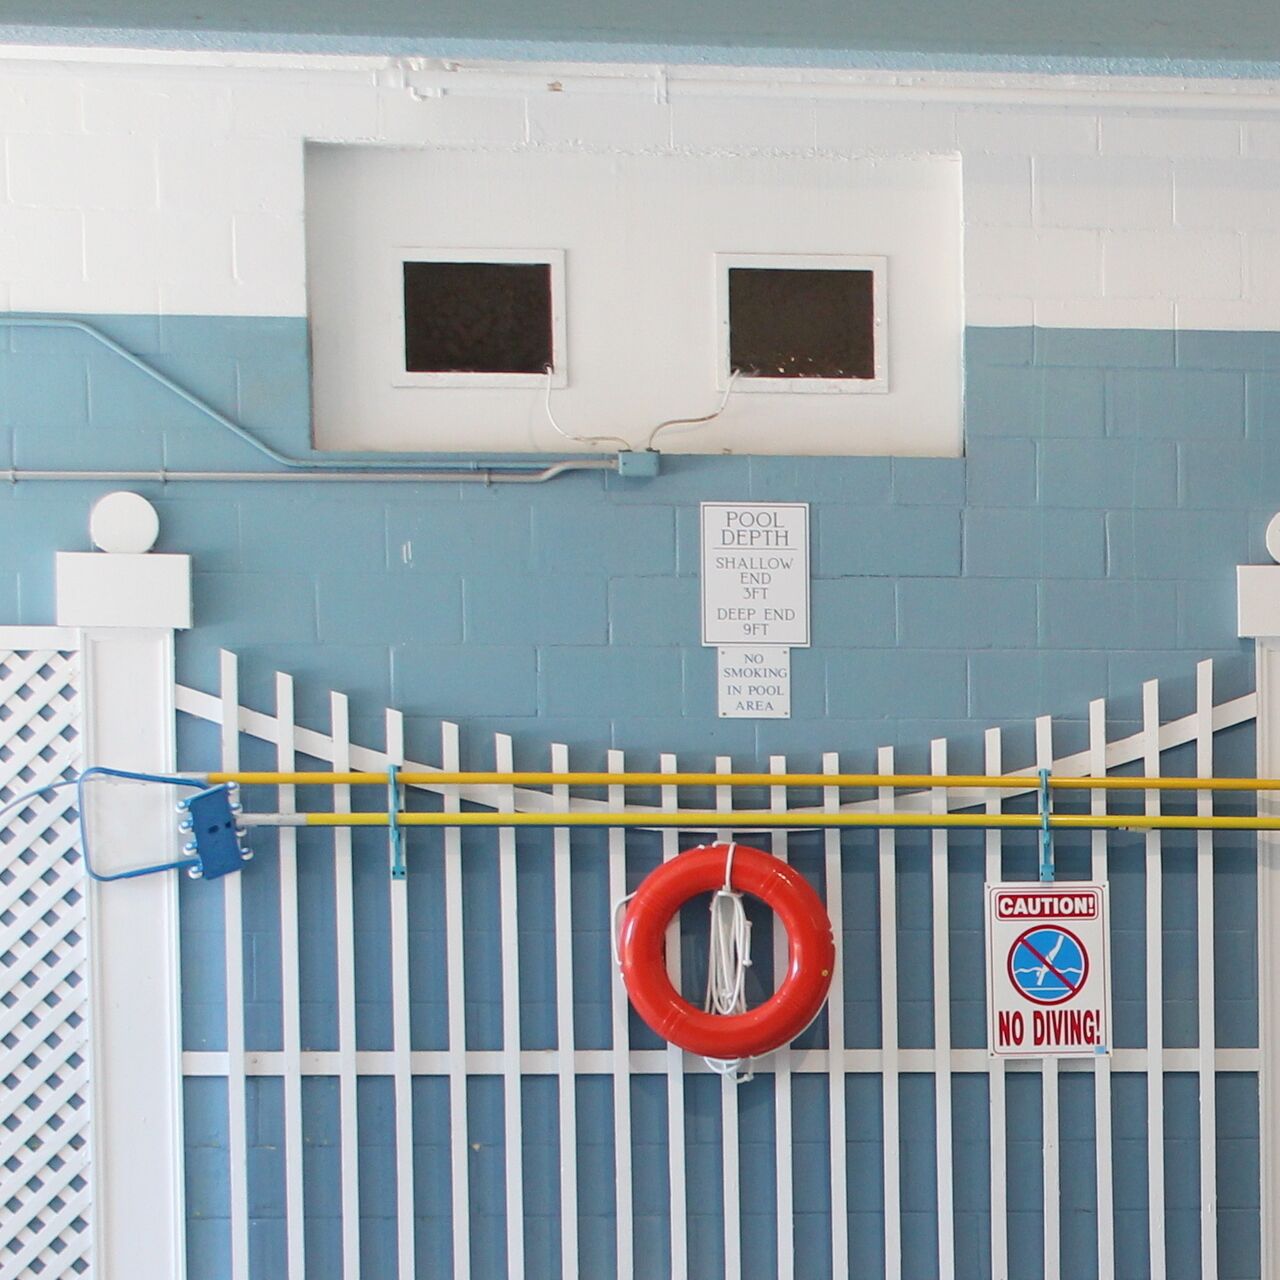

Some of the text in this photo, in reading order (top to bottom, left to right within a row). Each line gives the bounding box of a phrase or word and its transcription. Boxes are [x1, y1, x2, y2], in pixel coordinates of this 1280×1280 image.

[726, 511, 785, 528] POOL
[721, 529, 789, 546] DEPTH
[715, 557, 794, 570] SHALLOW
[740, 572, 772, 585] END
[743, 587, 769, 600] 3FT
[717, 608, 796, 621] DEEP END
[743, 623, 769, 636] 9FT
[744, 653, 764, 664] NO
[723, 667, 788, 679] SMOKING
[727, 685, 784, 696] IN POOL
[735, 701, 774, 711] AREA
[1000, 897, 1095, 916] CAUTION!
[999, 1009, 1101, 1046] NO DIVING!
